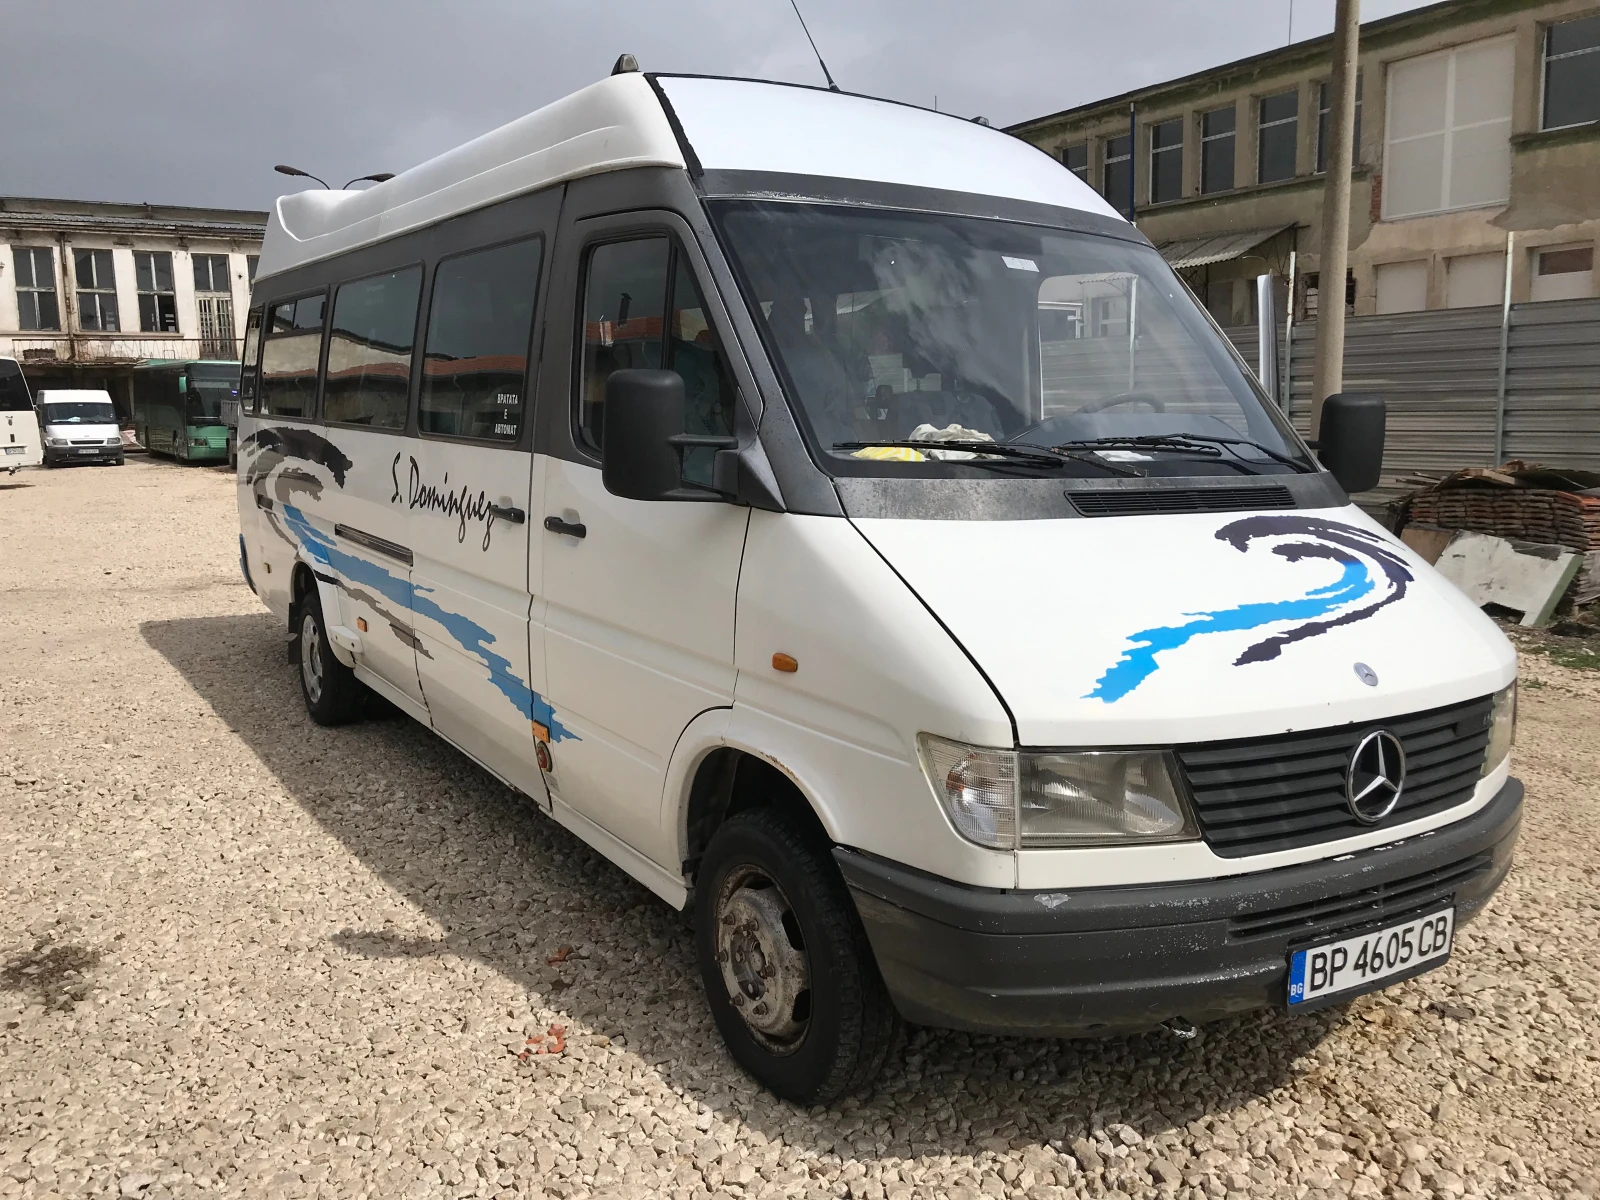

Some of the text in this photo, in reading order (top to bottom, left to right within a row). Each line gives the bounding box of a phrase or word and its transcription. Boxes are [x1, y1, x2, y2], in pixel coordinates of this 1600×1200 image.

[497, 394, 518, 404] ВРАТАТА
[503, 408, 508, 420] Е
[494, 423, 517, 435] АВТОМАТ
[391, 452, 494, 552] S. Dominguez
[1310, 915, 1448, 992] BP 4605 CB
[1290, 983, 1303, 996] BG
